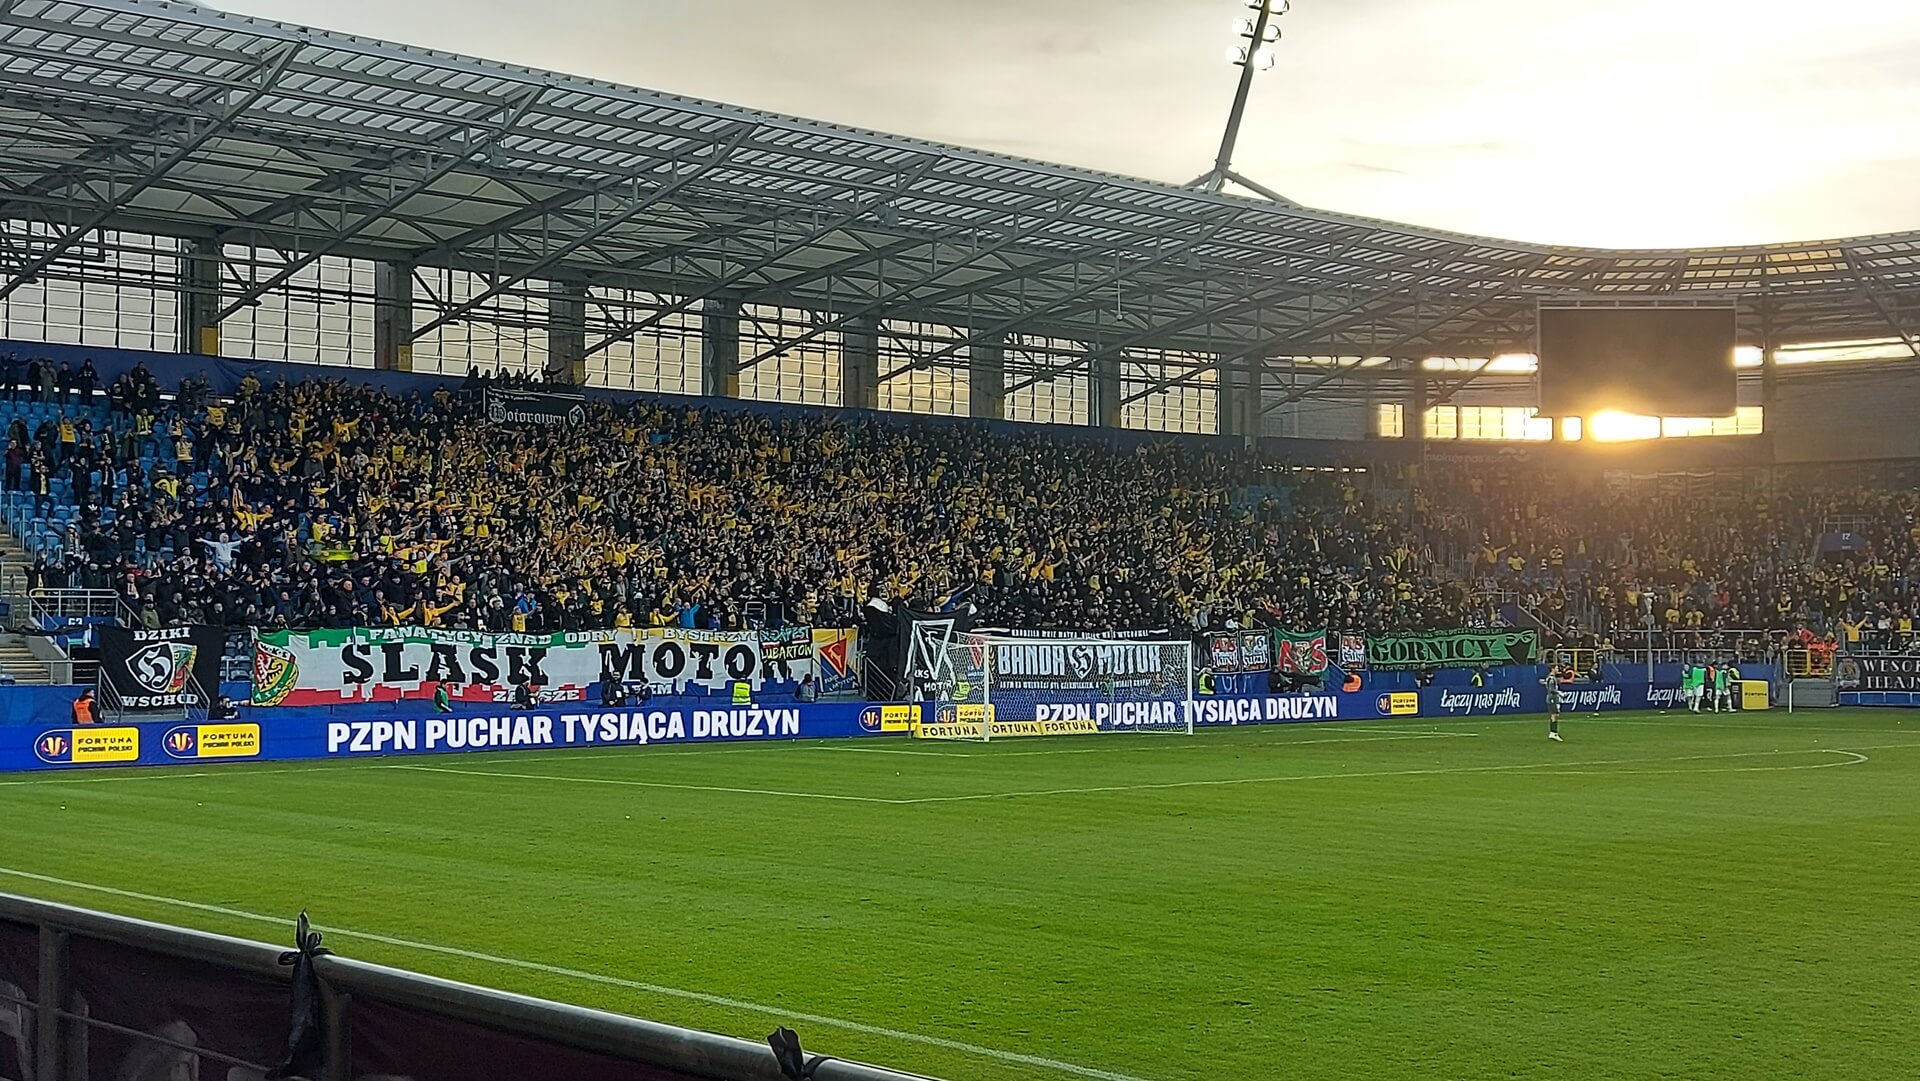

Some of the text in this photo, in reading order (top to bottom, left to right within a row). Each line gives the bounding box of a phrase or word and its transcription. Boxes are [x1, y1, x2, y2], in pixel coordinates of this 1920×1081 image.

[134, 627, 191, 641] DZIKI
[564, 630, 617, 643] ODRY
[1440, 686, 1520, 715] Łączy nas piłka
[1580, 690, 1598, 705] nas
[1596, 685, 1621, 711] piłka
[1646, 684, 1675, 708] Łączy
[1096, 701, 1176, 726] PUCHAR
[1181, 698, 1262, 724] TYSIĄCA
[1266, 692, 1338, 720] DRUŻYN
[328, 704, 799, 753] PZPN PUCHAR TYSIĄCA DRUŻYN
[922, 725, 979, 737] FORTUNA
[1045, 720, 1094, 732] FORTUNA
[78, 737, 132, 745] FORTUNA
[203, 733, 254, 743] FORTUNA
